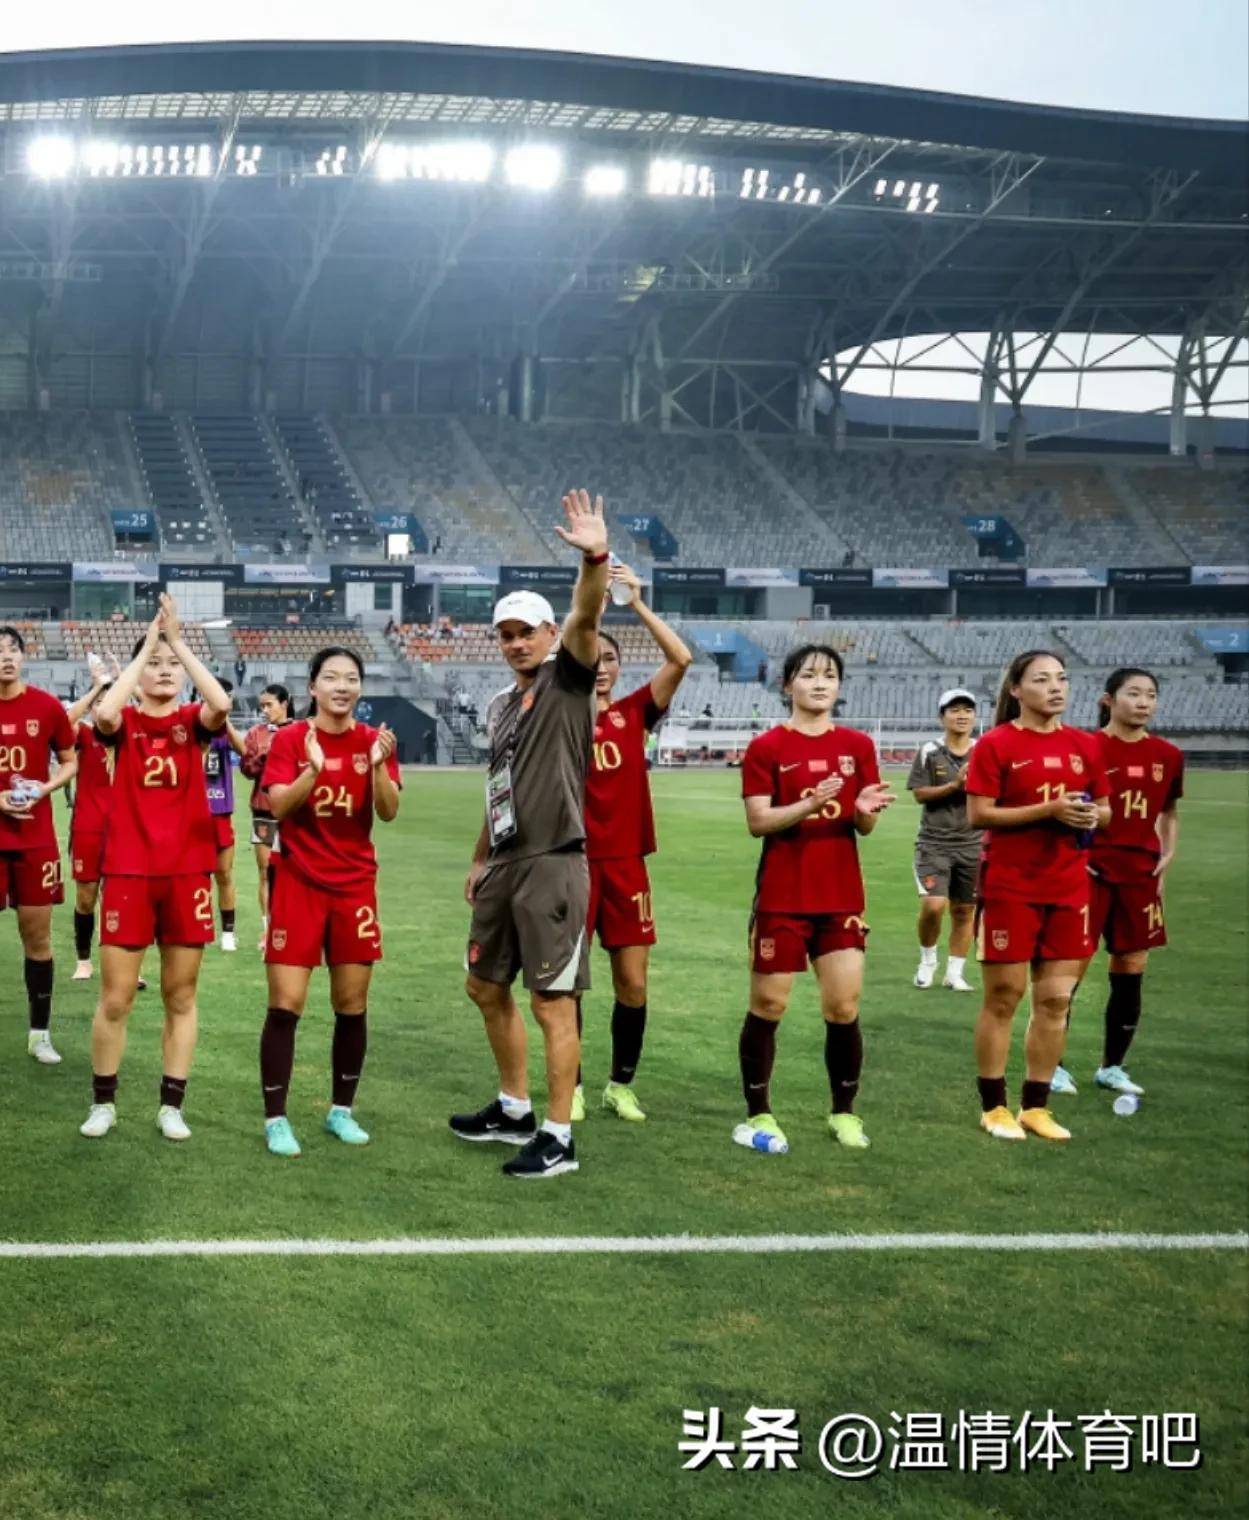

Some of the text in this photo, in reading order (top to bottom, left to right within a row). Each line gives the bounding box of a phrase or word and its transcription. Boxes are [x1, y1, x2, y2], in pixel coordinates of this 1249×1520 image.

[132, 513, 147, 527] 25
[391, 515, 407, 528] 26
[633, 518, 649, 531] 27
[978, 519, 996, 532] 28
[592, 741, 621, 771] 10
[144, 756, 177, 786] 21
[314, 786, 352, 817] 24
[1119, 790, 1147, 819] 14
[1143, 903, 1164, 929] 14
